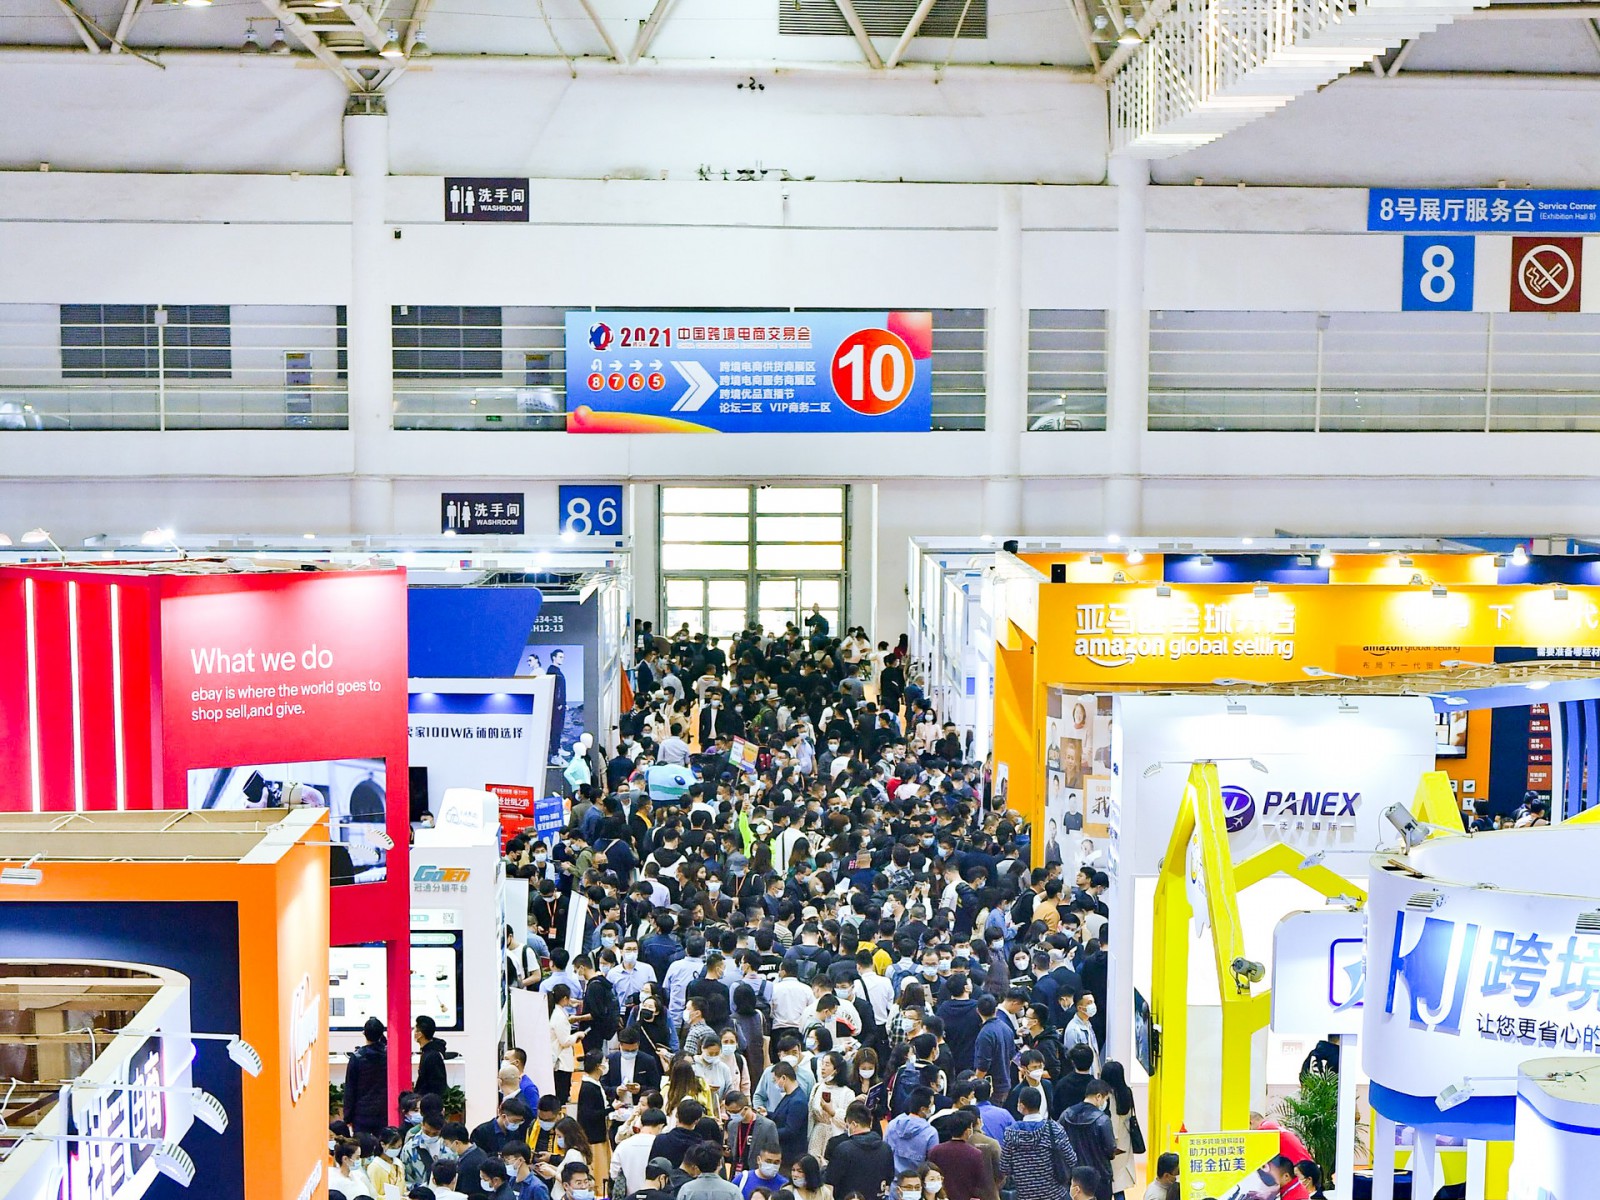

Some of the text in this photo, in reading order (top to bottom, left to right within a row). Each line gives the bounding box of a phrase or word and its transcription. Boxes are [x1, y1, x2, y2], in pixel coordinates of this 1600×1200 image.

[478, 188, 525, 203] 洗手间
[1379, 197, 1535, 222] 8号展厅服务台
[1538, 202, 1597, 210] Service Corner
[1539, 212, 1573, 220] (Exhibition
[1574, 212, 1588, 220] Hall
[1420, 245, 1455, 303] 8
[620, 327, 671, 347] 2021
[677, 327, 811, 341] 中国跨境电商交易会
[719, 361, 816, 372] 跨境电商供货商展区
[838, 344, 906, 401] 10
[592, 377, 660, 387] 8 7 6 5
[719, 375, 816, 386] 跨境电商服务商展区
[719, 388, 795, 399] 跨境优品直播节
[719, 402, 832, 413] 论坛二区 VIP商务二区
[474, 503, 520, 517] 洗手间
[1076, 603, 1295, 634] 亚马全球店
[1074, 637, 1294, 660] amazon global selling
[191, 645, 333, 674] What we do
[1363, 661, 1446, 670] 布局下一代贸
[191, 679, 381, 702] ebay is where the world goes to
[191, 707, 222, 724] shop
[276, 703, 305, 721] give.
[1262, 791, 1361, 816] PANEX
[1476, 1012, 1600, 1047] 让您更省心的
[1189, 1146, 1246, 1157] 助力中国卖家
[1190, 1157, 1246, 1173] 掘金拉美
